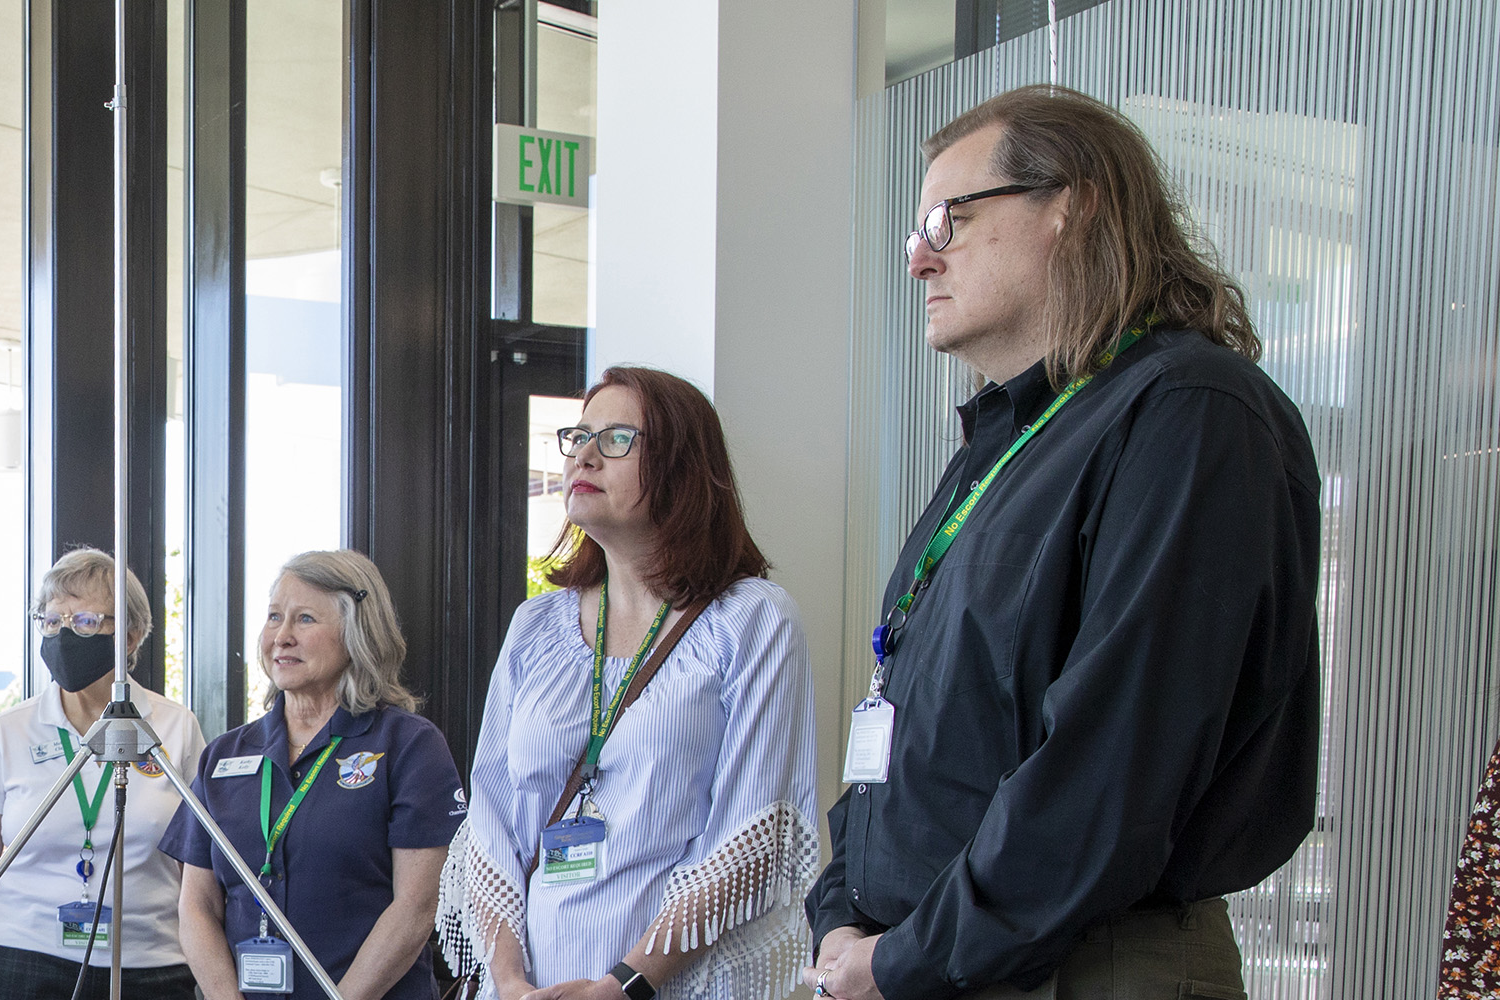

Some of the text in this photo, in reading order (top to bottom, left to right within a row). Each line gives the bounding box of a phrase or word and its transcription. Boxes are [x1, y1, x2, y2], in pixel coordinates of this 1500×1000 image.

[519, 135, 580, 197] EXIT
[1031, 419, 1044, 432] No
[1044, 389, 1073, 418] Escort
[944, 451, 1012, 537] No Escort Required
[651, 603, 668, 628] No Escort
[624, 672, 632, 681] No
[627, 655, 640, 673] Escort
[592, 683, 601, 736] No Escort Required
[602, 710, 613, 728] Escort
[598, 727, 607, 738] No
[300, 741, 336, 792] No Escort Required
[276, 804, 296, 831] Required
[556, 871, 581, 879] VISITOR
